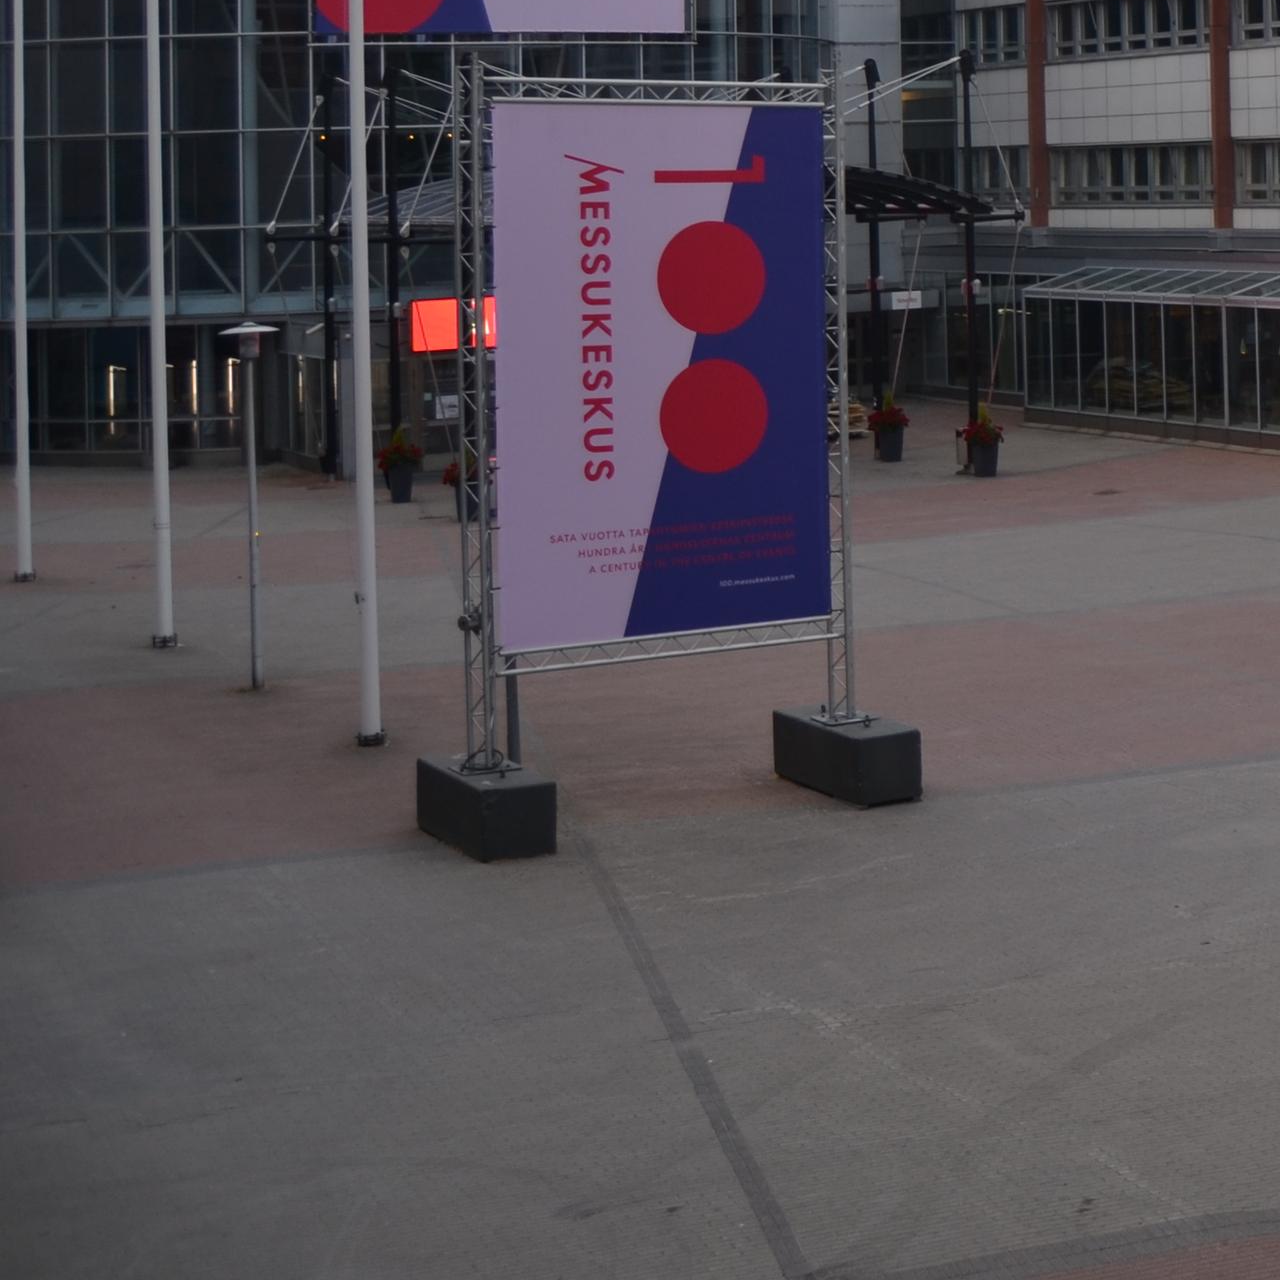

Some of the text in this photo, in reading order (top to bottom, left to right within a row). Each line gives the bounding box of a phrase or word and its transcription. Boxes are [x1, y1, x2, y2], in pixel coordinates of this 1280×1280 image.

[564, 153, 624, 482] MESSUKESKUS
[549, 529, 625, 545] SATA VUOTTA
[578, 547, 626, 559] HUNDRA
[588, 565, 597, 574] A
